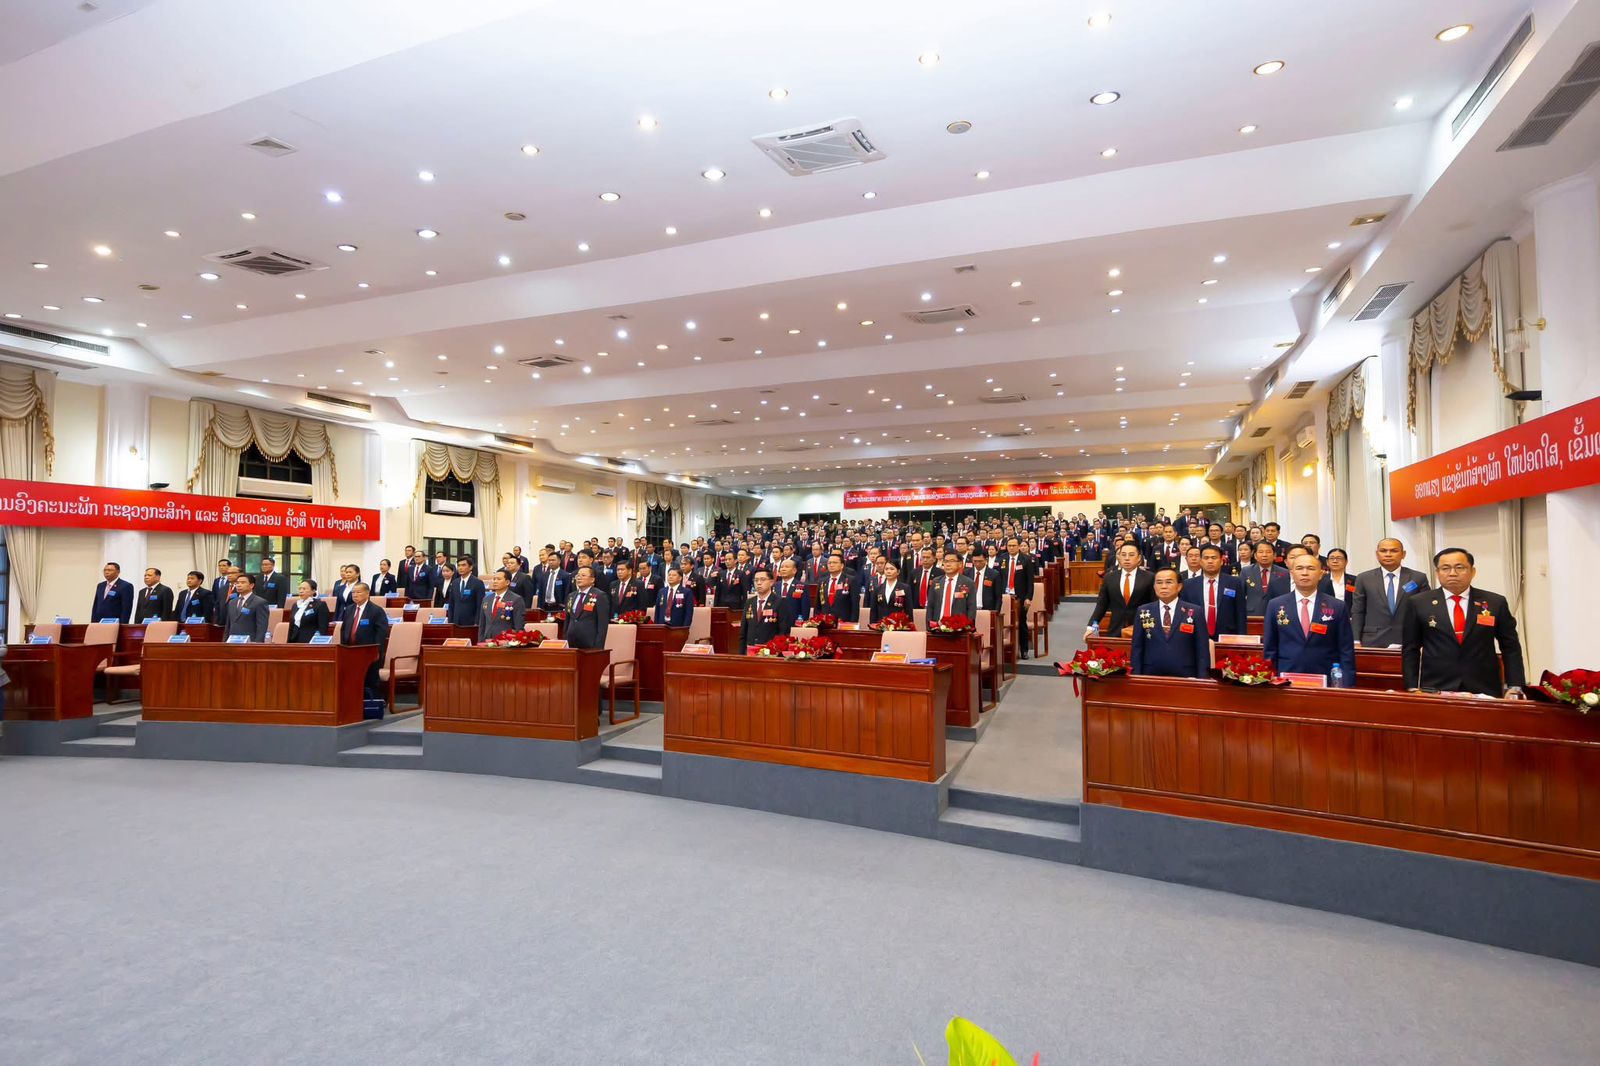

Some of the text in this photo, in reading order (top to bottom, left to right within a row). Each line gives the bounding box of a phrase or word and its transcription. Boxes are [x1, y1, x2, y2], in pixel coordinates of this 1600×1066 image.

[104, 501, 191, 521] ກະຊວງກະສິກຳ
[195, 509, 218, 522] ແລະ
[222, 501, 282, 526] ສິ່ງແວດລ້ອມ
[285, 507, 307, 528] ຄັ້ງທີ
[310, 516, 325, 529] VII
[327, 512, 367, 534] ຢ່າງສຸດໃຈ
